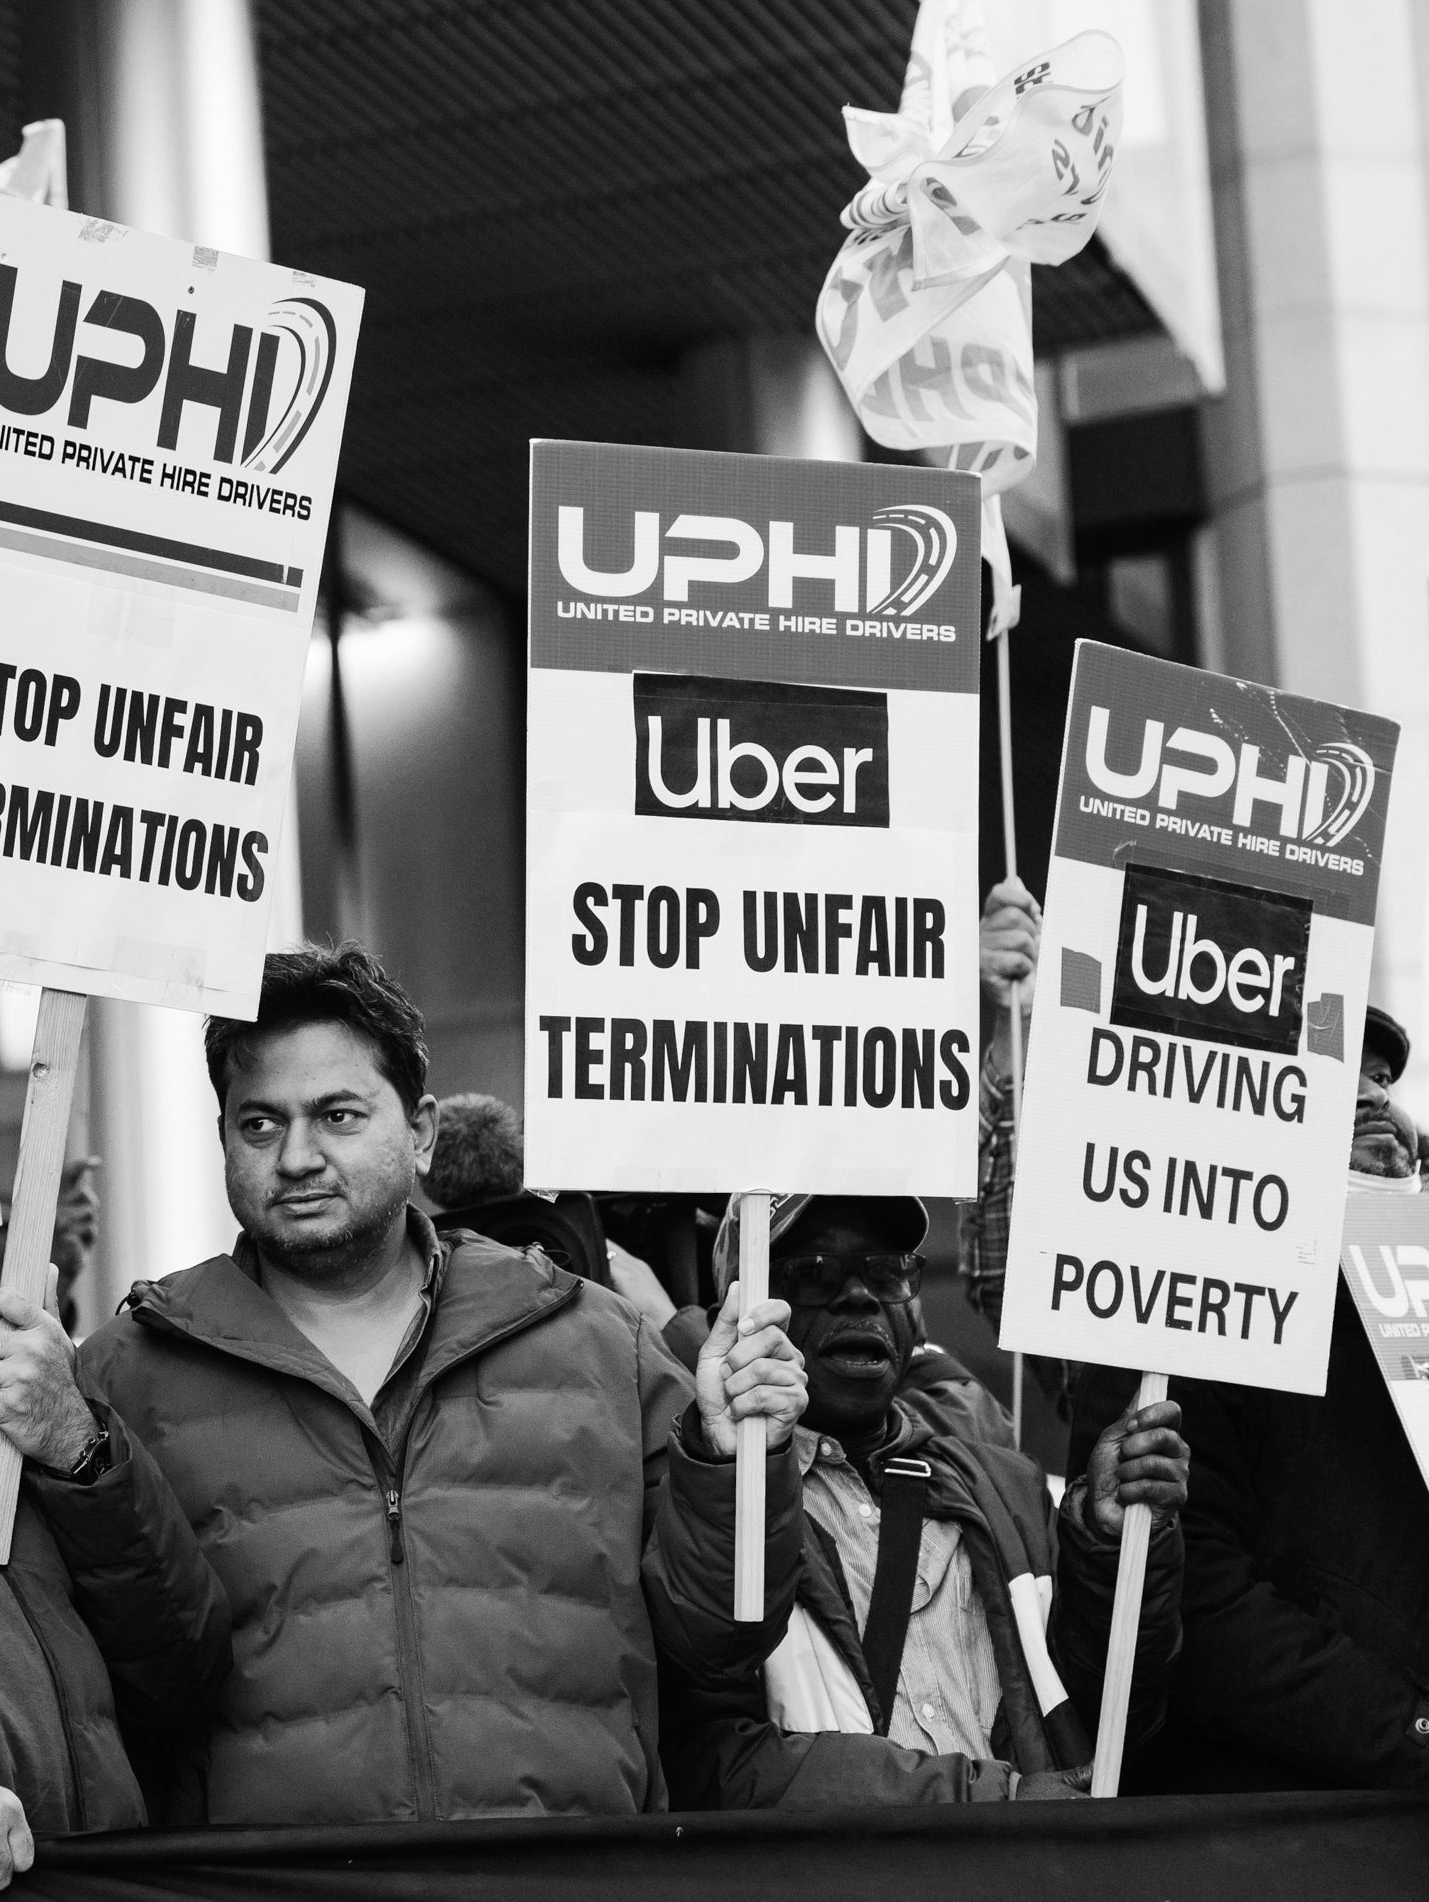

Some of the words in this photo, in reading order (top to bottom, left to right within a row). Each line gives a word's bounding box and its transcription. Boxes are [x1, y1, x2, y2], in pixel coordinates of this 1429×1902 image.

[61, 440, 154, 484] PRIVATE
[160, 463, 212, 498] HIRE
[217, 476, 313, 521] DRIVERS
[557, 601, 654, 623] UNITED
[663, 608, 770, 631] PRIVATE
[779, 615, 837, 635] HIRE
[845, 619, 956, 643] DRIVERS
[93, 684, 264, 785] UNFAIR
[648, 715, 873, 814] Uber
[1079, 796, 1150, 826] UNITED
[1155, 814, 1233, 846] PRIVATE
[1237, 833, 1280, 857] HIRE
[1285, 843, 1365, 876] DRIVERS
[571, 882, 720, 970] STOP
[742, 890, 946, 979] UNFAIR
[1131, 904, 1294, 1017] Uber
[539, 1015, 970, 1111] TERMINATIONS
[1087, 1027, 1308, 1124] DRIVING
[1082, 1142, 1151, 1208] US
[1163, 1156, 1289, 1231] INTO
[1051, 1253, 1299, 1345] POVERTY
[1348, 1245, 1429, 1318] UP
